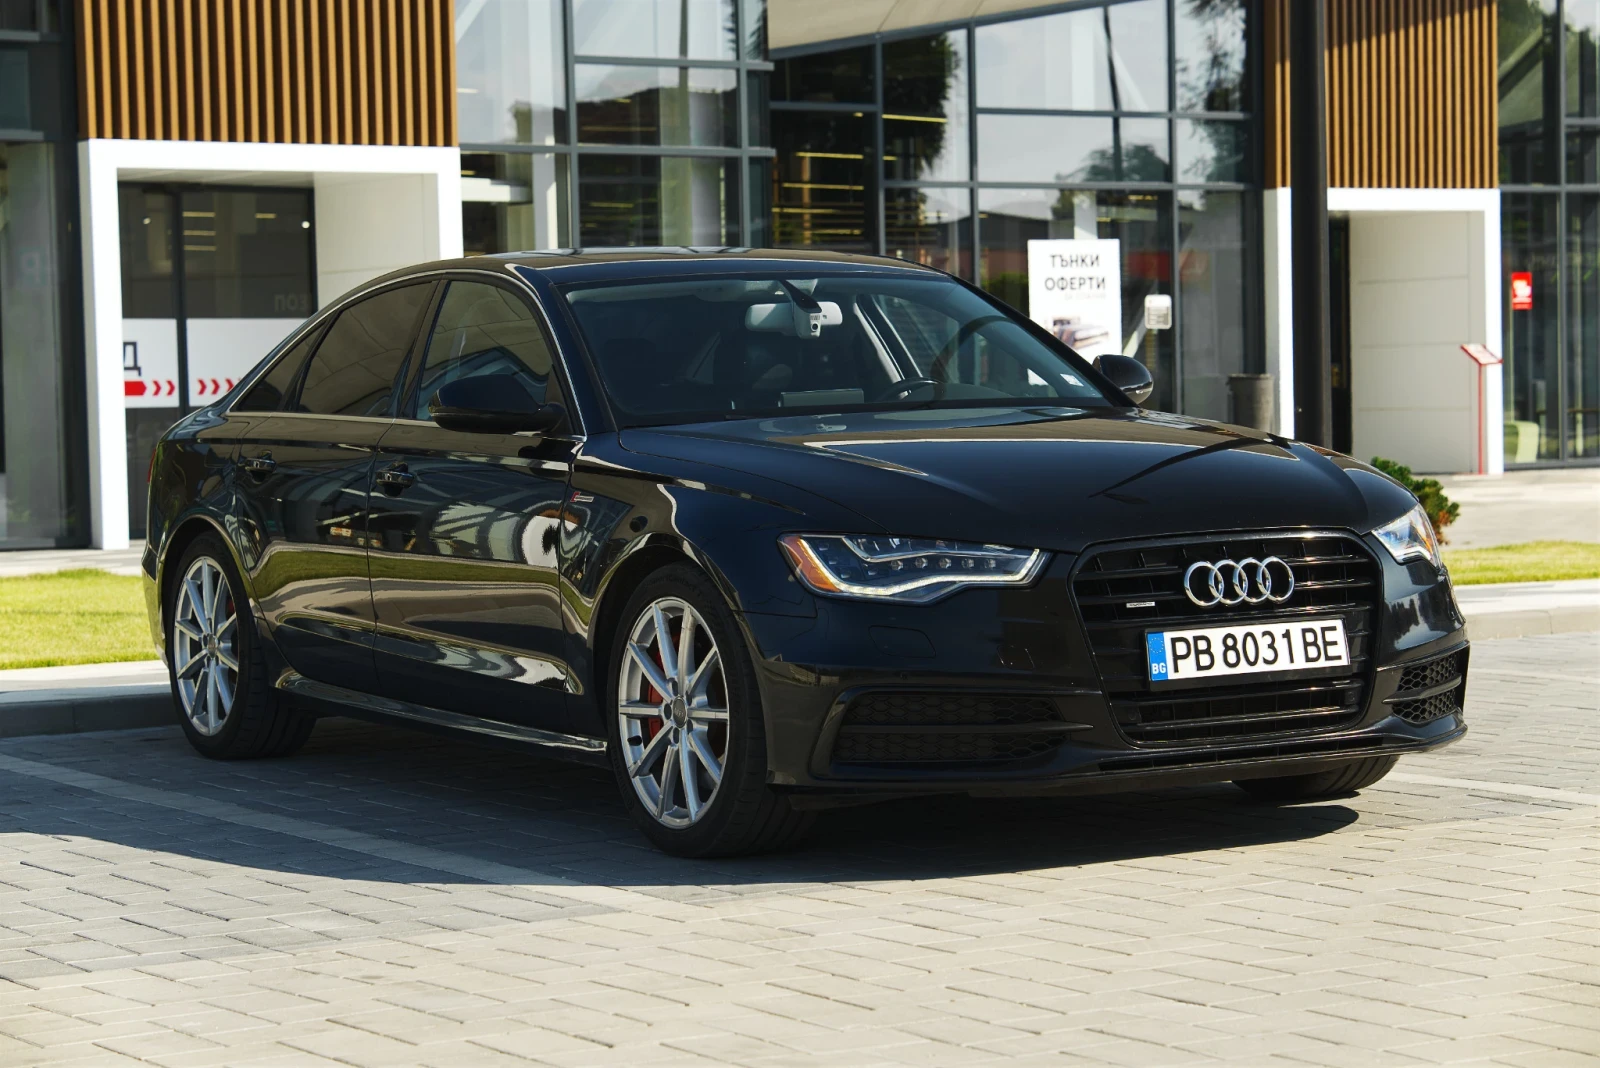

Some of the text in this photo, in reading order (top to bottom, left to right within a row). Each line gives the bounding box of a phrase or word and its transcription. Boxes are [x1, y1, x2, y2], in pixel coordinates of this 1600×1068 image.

[1050, 254, 1099, 268] ТЪНКИ
[1044, 277, 1106, 291] ОФЕРТИ
[1170, 625, 1343, 673] PB 8031 BE
[1151, 662, 1167, 675] BG
